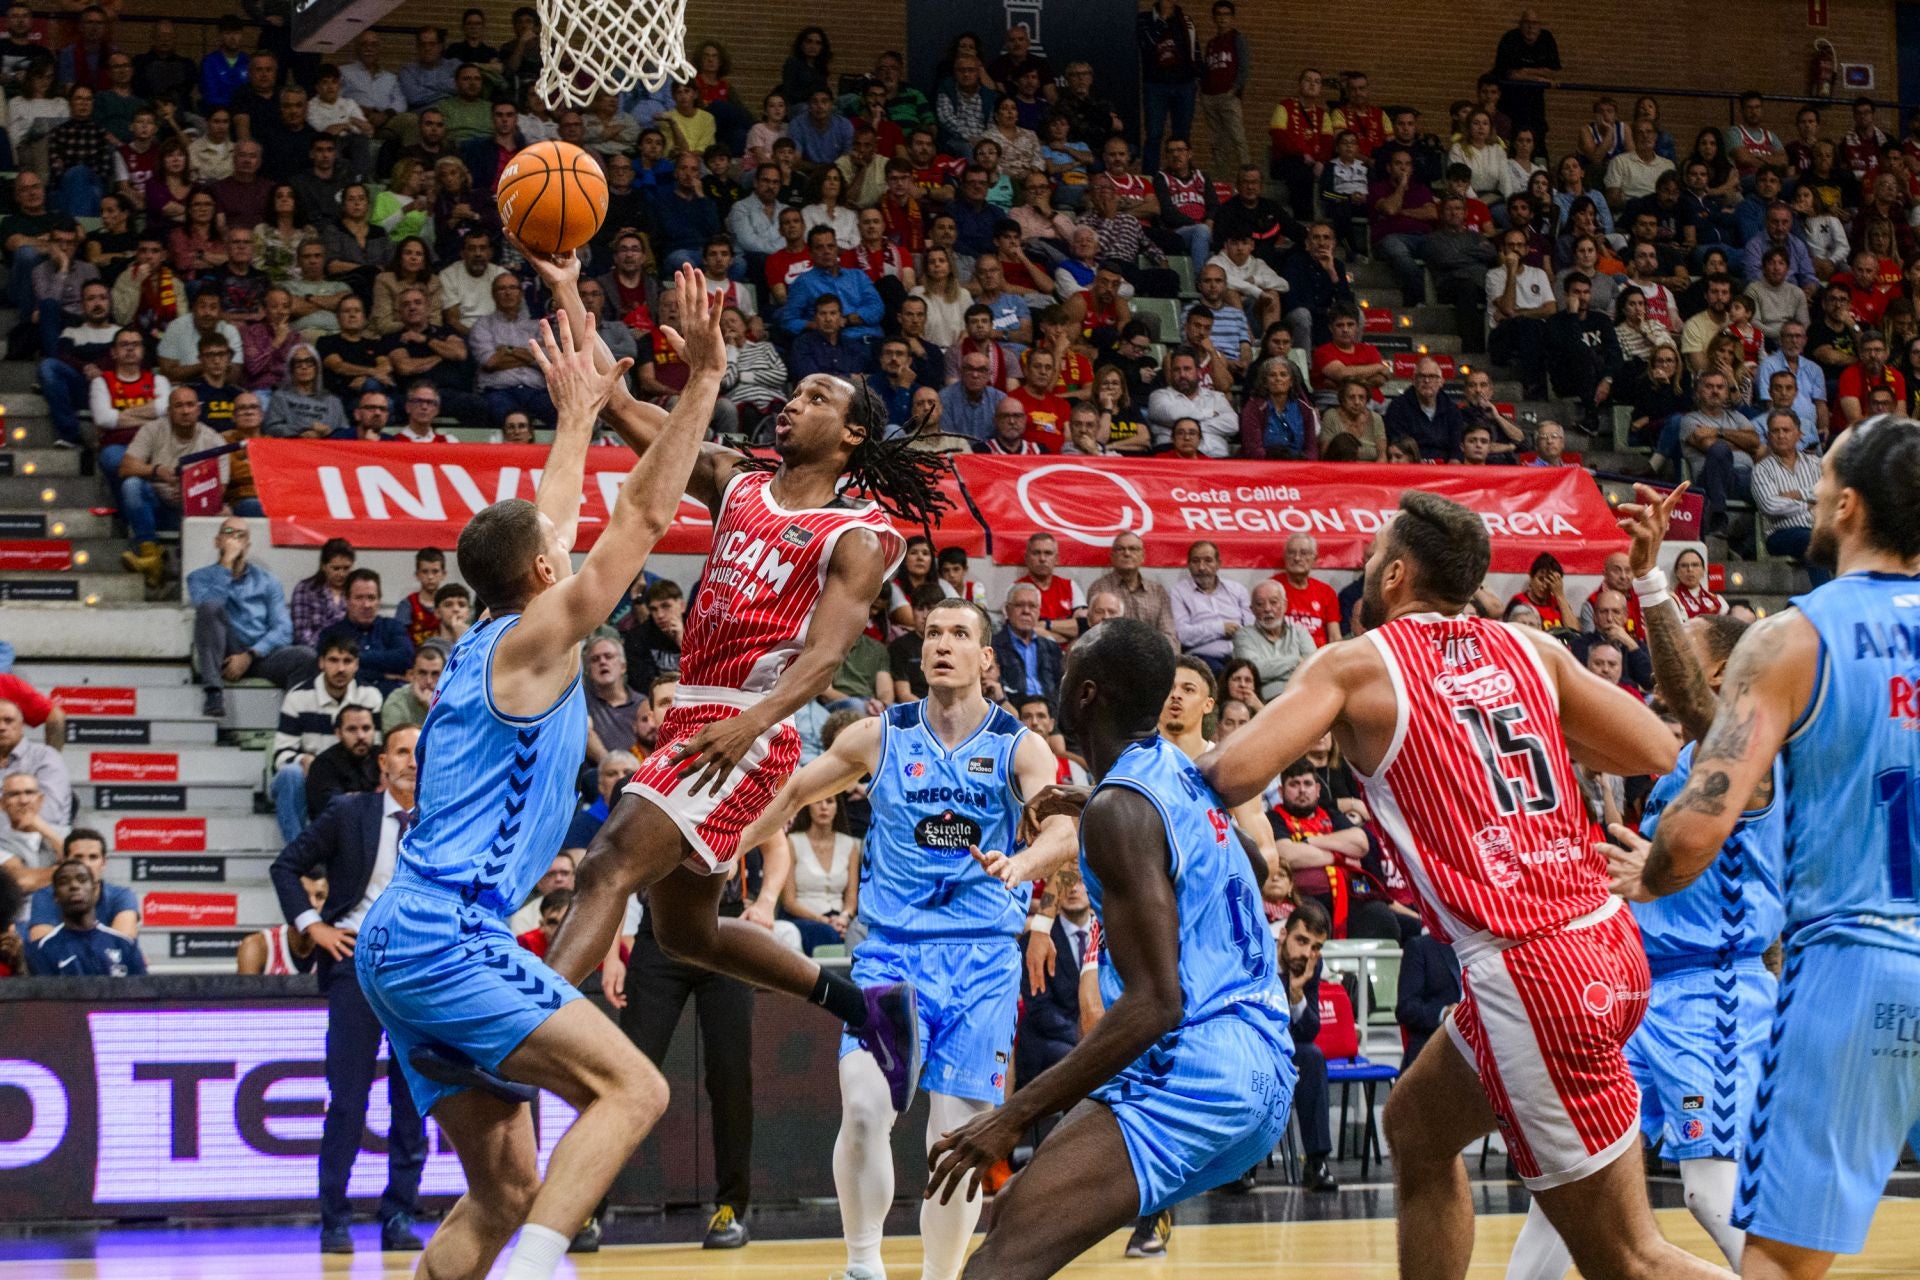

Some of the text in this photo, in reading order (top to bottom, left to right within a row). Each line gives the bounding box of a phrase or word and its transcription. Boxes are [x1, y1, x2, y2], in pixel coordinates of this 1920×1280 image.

[1170, 487, 1231, 503] Costa
[1180, 505, 1582, 536] REGIÓN D RCIA
[712, 530, 796, 596] UCAM
[709, 566, 757, 601] MURCIA
[1452, 703, 1560, 816] 15
[906, 787, 987, 809] BREOGÁN
[925, 822, 971, 835] Estrella
[927, 835, 970, 847] Galicia
[1874, 1016, 1896, 1030] DE
